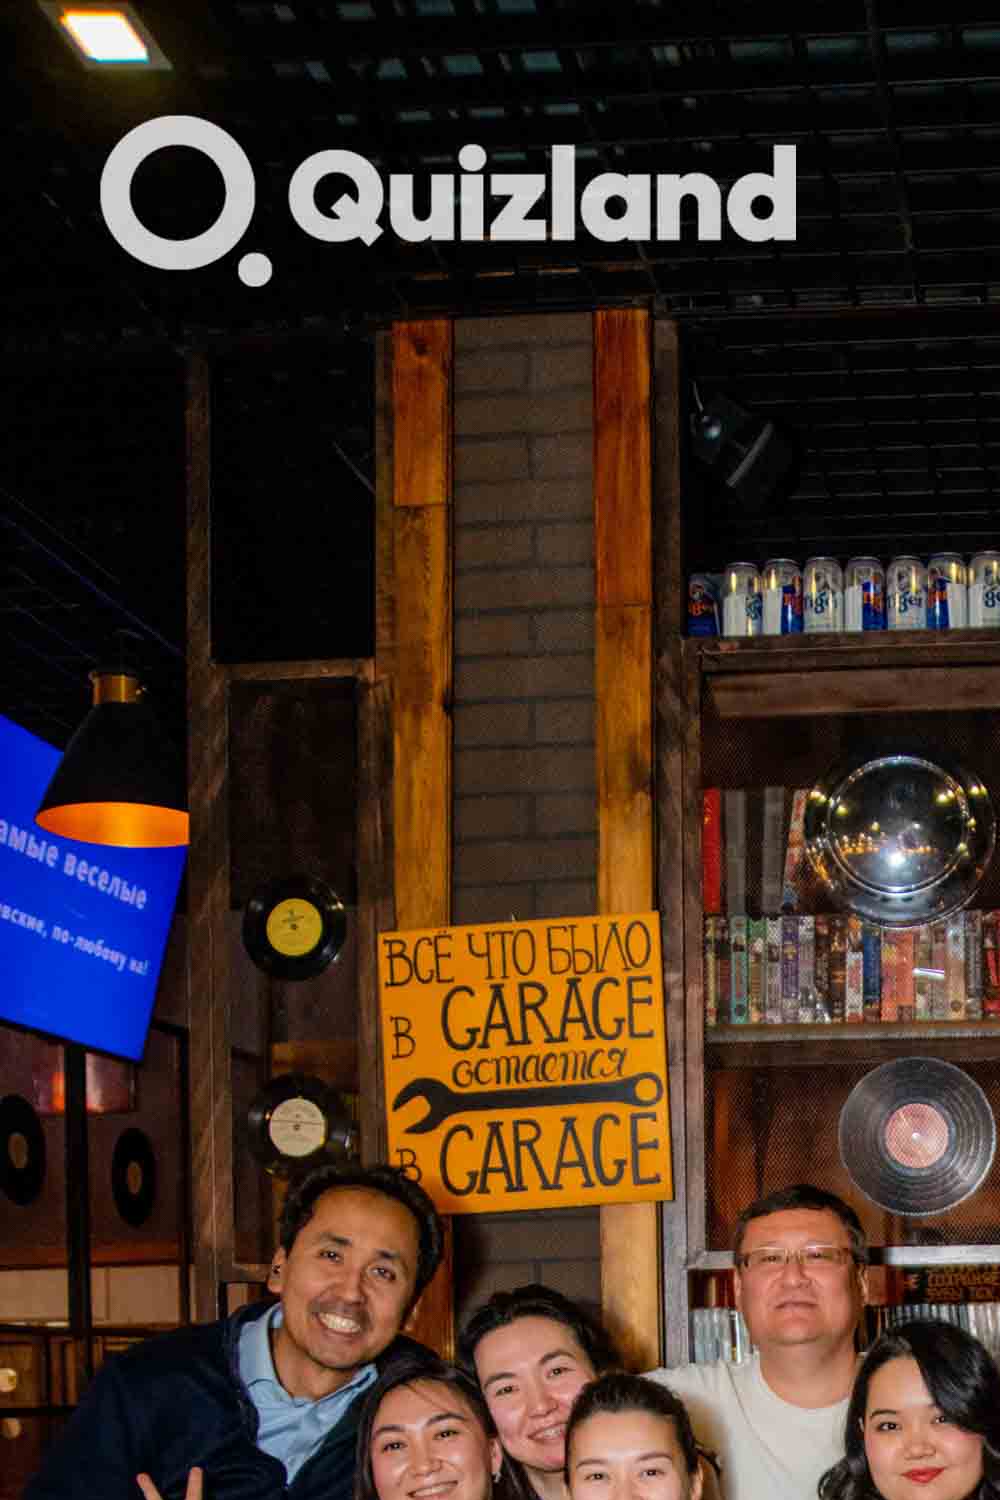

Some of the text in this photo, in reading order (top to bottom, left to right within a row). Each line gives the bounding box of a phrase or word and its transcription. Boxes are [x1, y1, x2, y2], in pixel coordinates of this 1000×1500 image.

[0, 818, 147, 911] амые веселые
[383, 930, 455, 987] ВСЁ
[466, 927, 536, 980] ЧТО
[547, 920, 651, 976] БЫЛО
[441, 976, 655, 1051] GARAGE
[451, 1047, 628, 1088] остается
[439, 1111, 661, 1196] GARAGE
